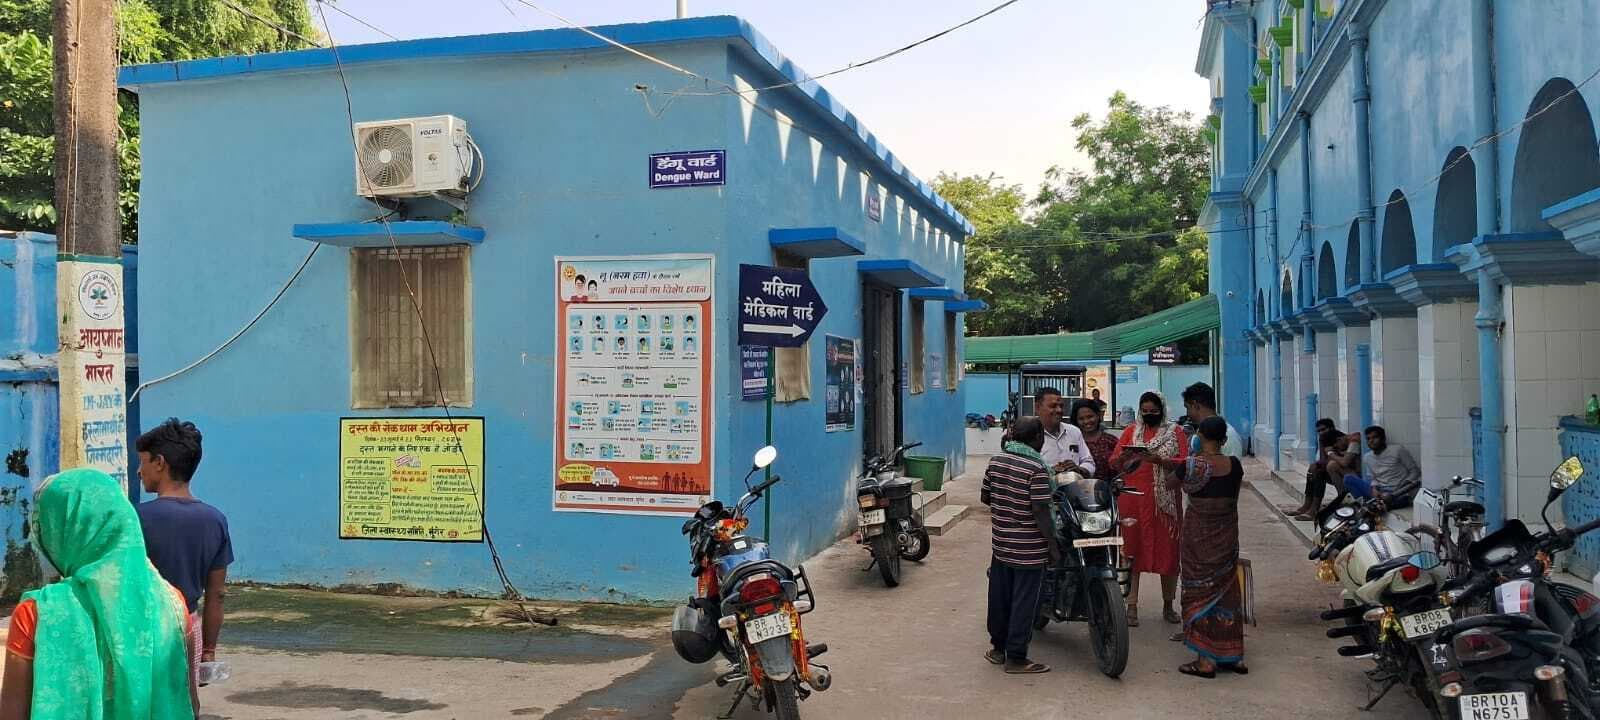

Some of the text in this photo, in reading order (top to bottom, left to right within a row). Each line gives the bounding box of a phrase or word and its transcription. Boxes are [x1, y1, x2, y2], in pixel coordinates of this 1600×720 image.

[420, 128, 442, 136] VOLTAS
[656, 154, 718, 171] डेंगू वार्ड
[655, 169, 720, 183] Dengue Ward
[650, 285, 661, 294] का
[686, 284, 707, 294] ध्यान
[761, 275, 802, 299] महिला
[743, 296, 814, 321] मेडिकल वार्ड
[80, 328, 124, 359] आयुष्मान
[85, 364, 114, 385] भारत
[349, 424, 368, 436] दस्त
[369, 421, 381, 434] की
[420, 420, 470, 435] अभियान
[361, 523, 378, 536] जिला
[754, 614, 785, 630] BR 10
[1413, 610, 1442, 625] BR08
[756, 623, 789, 640] N3235
[1471, 694, 1519, 708] BR10A
[1472, 707, 1519, 720] N6751
